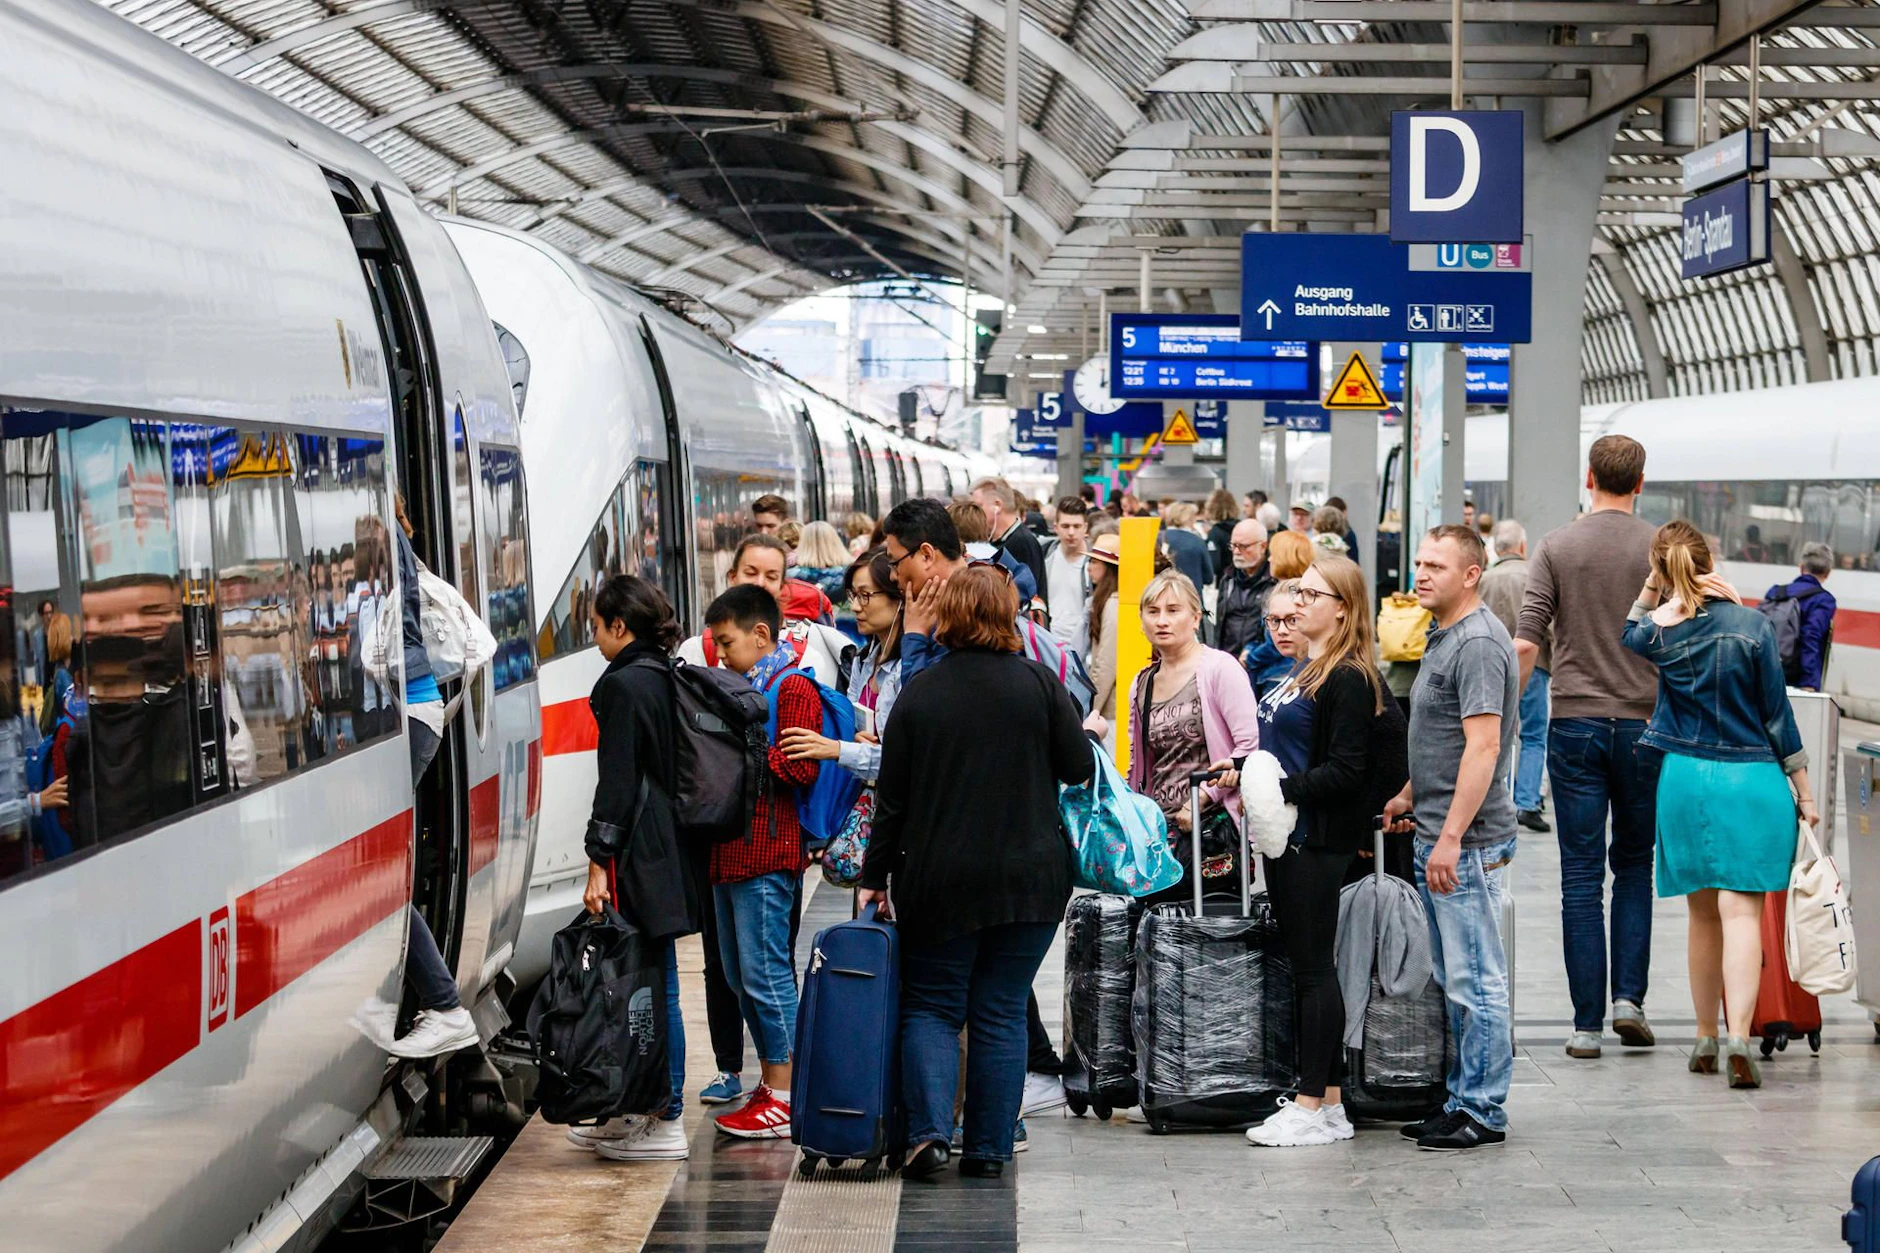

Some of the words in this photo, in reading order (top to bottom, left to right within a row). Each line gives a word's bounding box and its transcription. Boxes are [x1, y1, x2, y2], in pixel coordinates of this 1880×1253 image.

[1409, 116, 1481, 212] D
[1471, 250, 1489, 260] Bus
[1294, 284, 1354, 302] Ausgang
[1294, 302, 1391, 317] Bahnhofshalle
[1122, 326, 1137, 348] 5
[1159, 342, 1208, 353] München
[1041, 391, 1061, 421] 5
[210, 921, 228, 1016] DB
[628, 1010, 639, 1037] THE
[638, 1010, 649, 1056] NORTH
[645, 1009, 656, 1042] FACE
